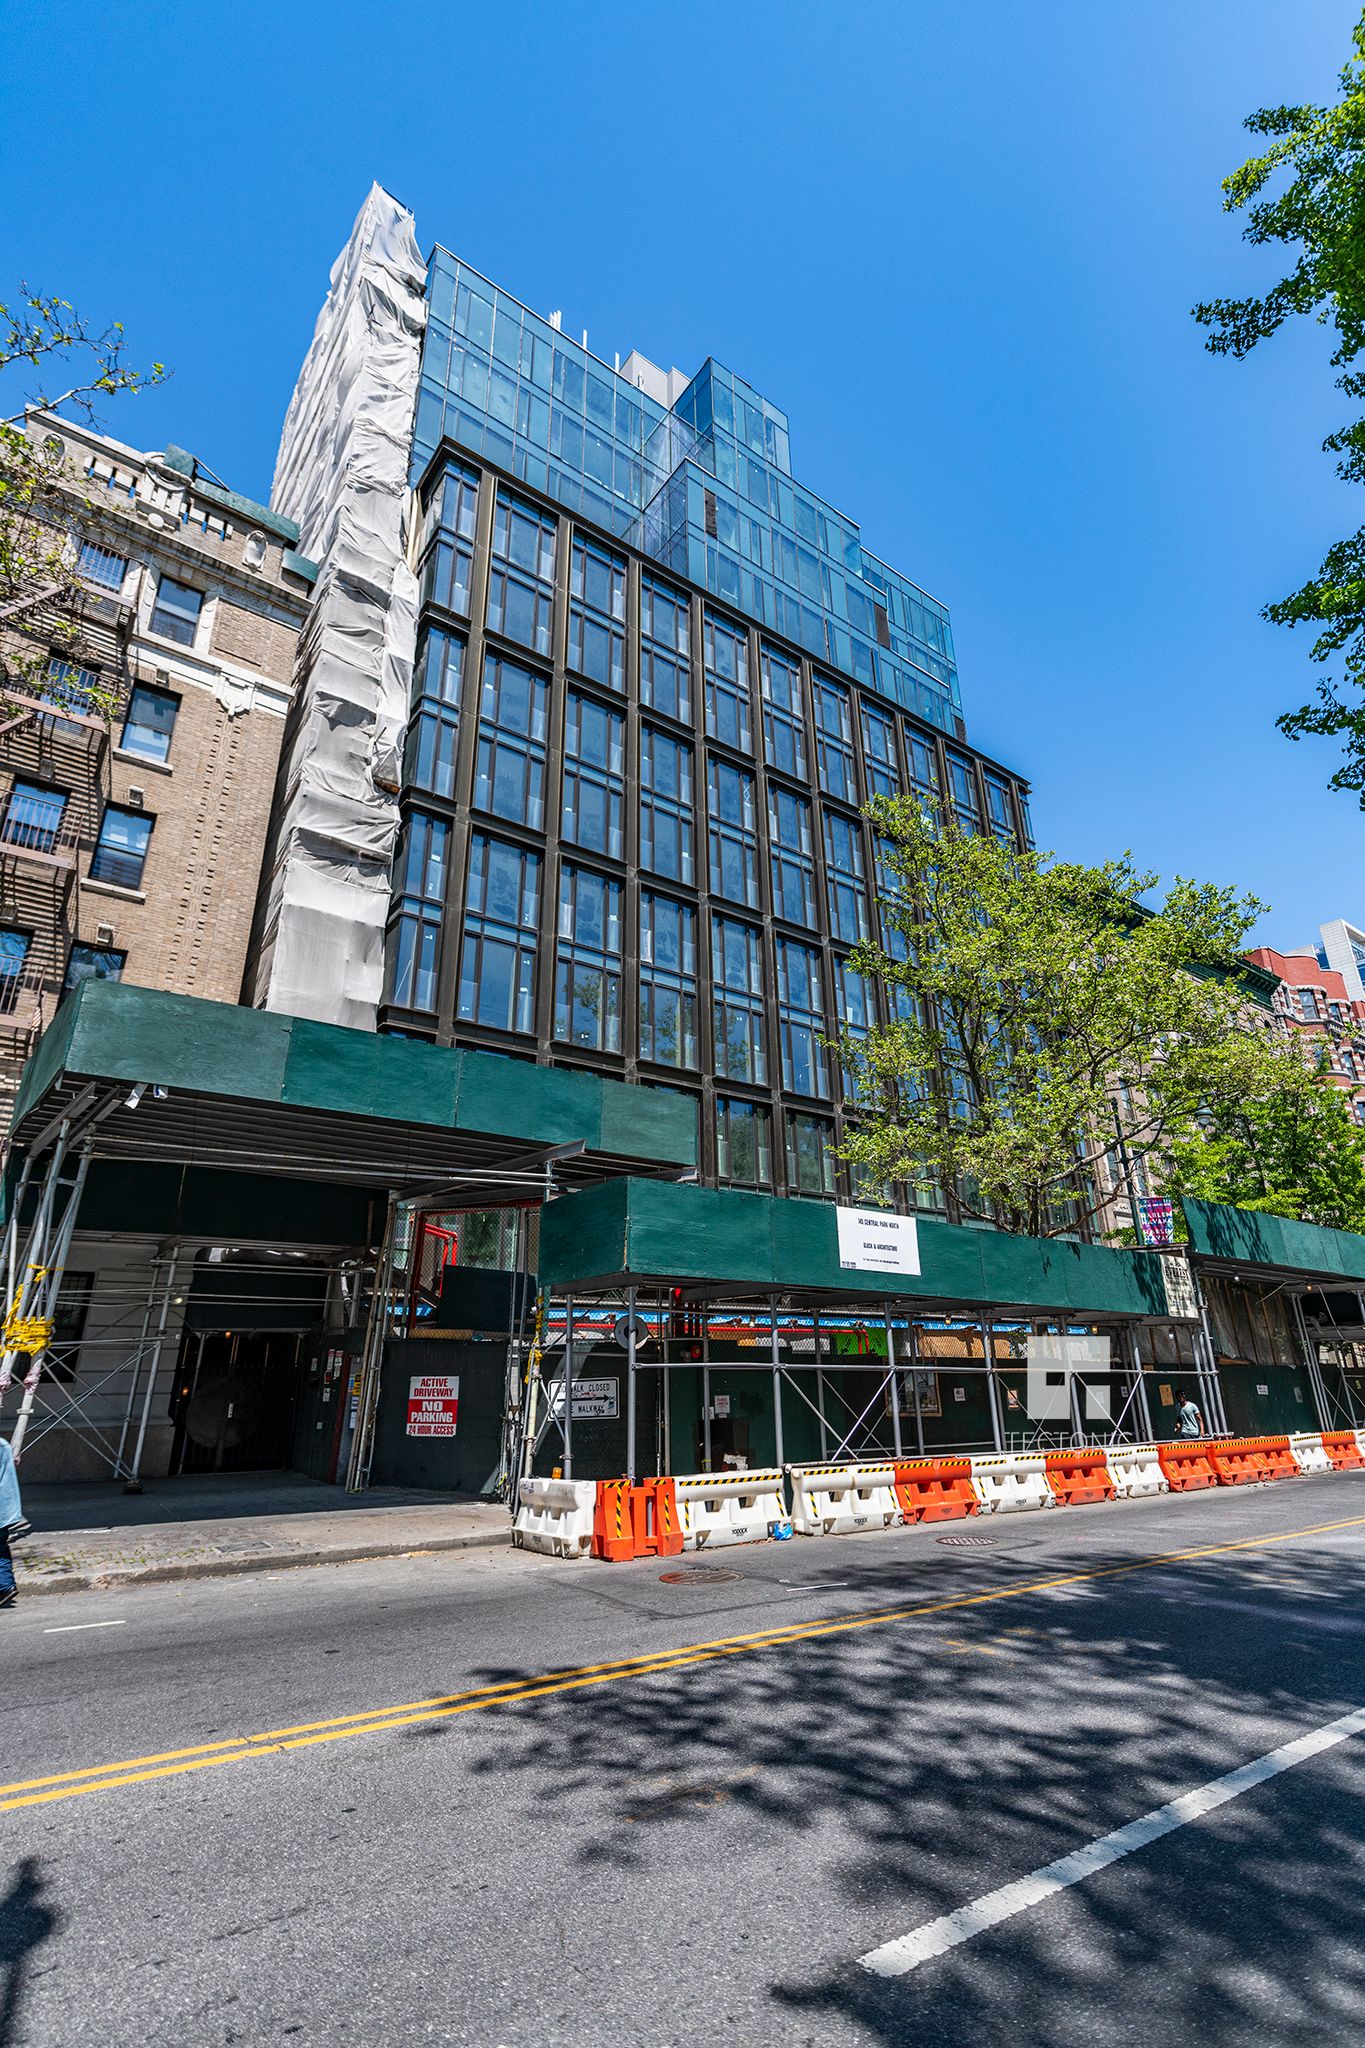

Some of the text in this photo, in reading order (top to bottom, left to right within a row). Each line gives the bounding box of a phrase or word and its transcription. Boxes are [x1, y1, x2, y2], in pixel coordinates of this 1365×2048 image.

[420, 1378, 448, 1387] ACTIVE
[588, 1383, 610, 1392] CLOSED
[413, 1388, 454, 1397] DRIVEWAY
[422, 1401, 443, 1412] NO
[578, 1405, 604, 1413] WALKWAY
[410, 1412, 453, 1422] PARKING
[408, 1425, 454, 1435] 24 HOUR ACCESS
